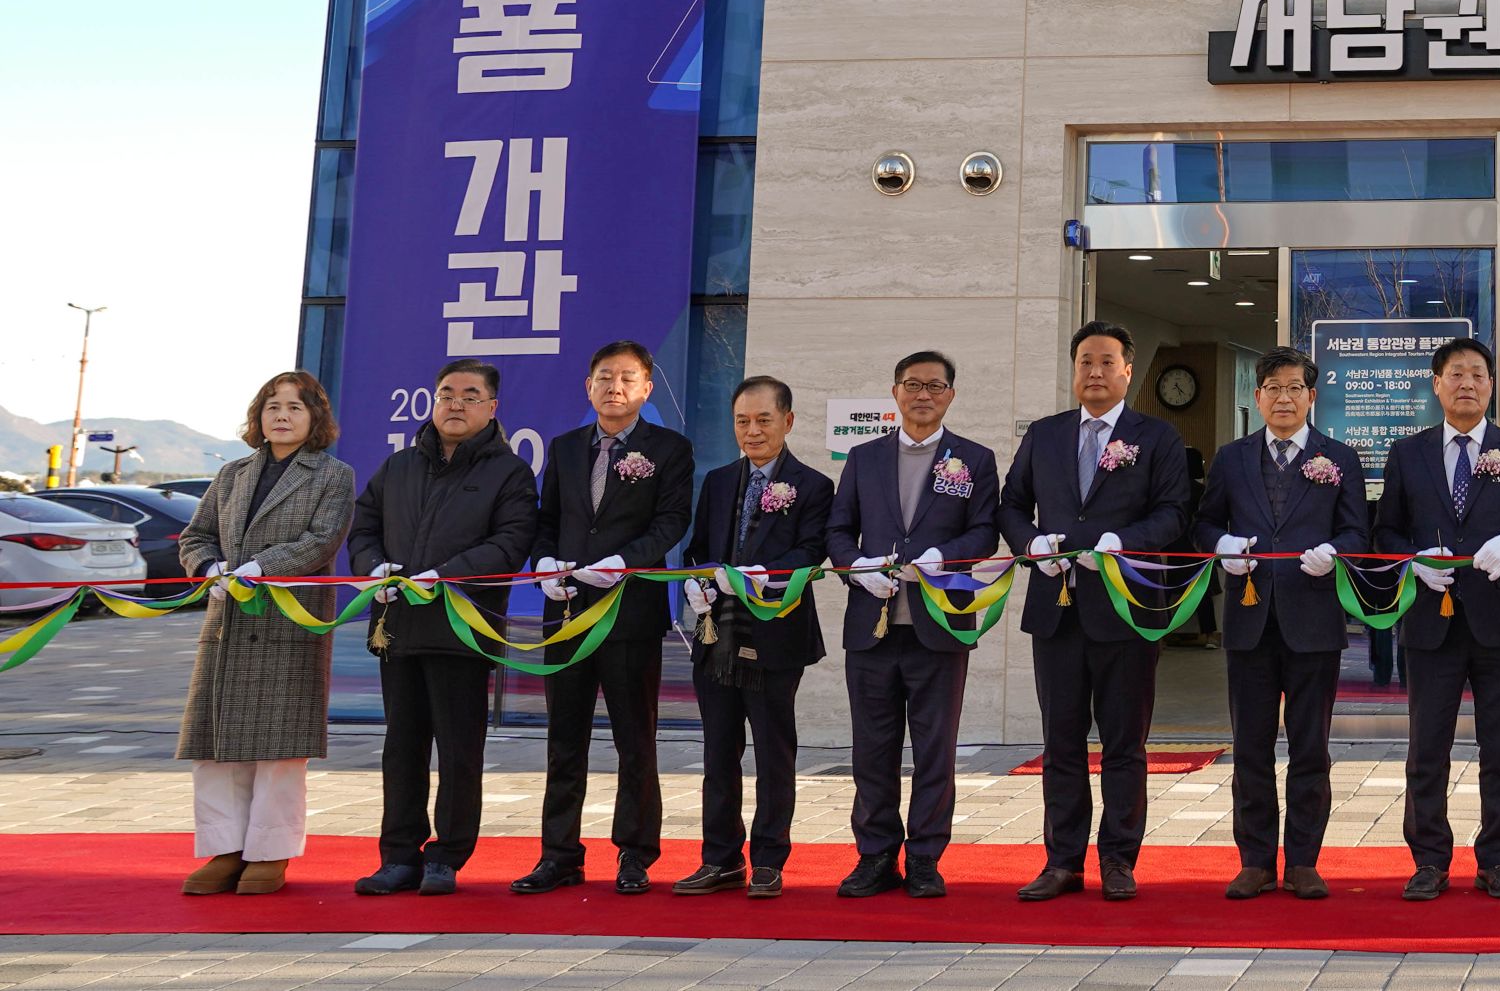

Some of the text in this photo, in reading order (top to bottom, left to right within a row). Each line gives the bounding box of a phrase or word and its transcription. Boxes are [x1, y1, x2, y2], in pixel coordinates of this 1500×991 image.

[443, 136, 577, 358] 개관
[1326, 337, 1364, 351] 서남권
[1366, 336, 1417, 351] 통합관광
[1326, 370, 1337, 384] 2
[1345, 369, 1369, 379] 서남권
[1370, 369, 1393, 379] 기념품
[1345, 381, 1374, 391] 09:00
[1384, 380, 1411, 390] 18:00
[850, 412, 896, 422] 대한민국 4대
[833, 425, 879, 435] 관광거점도시
[1345, 426, 1369, 436] 서남권
[1371, 426, 1388, 436] 통합
[1345, 438, 1374, 447] 09:00
